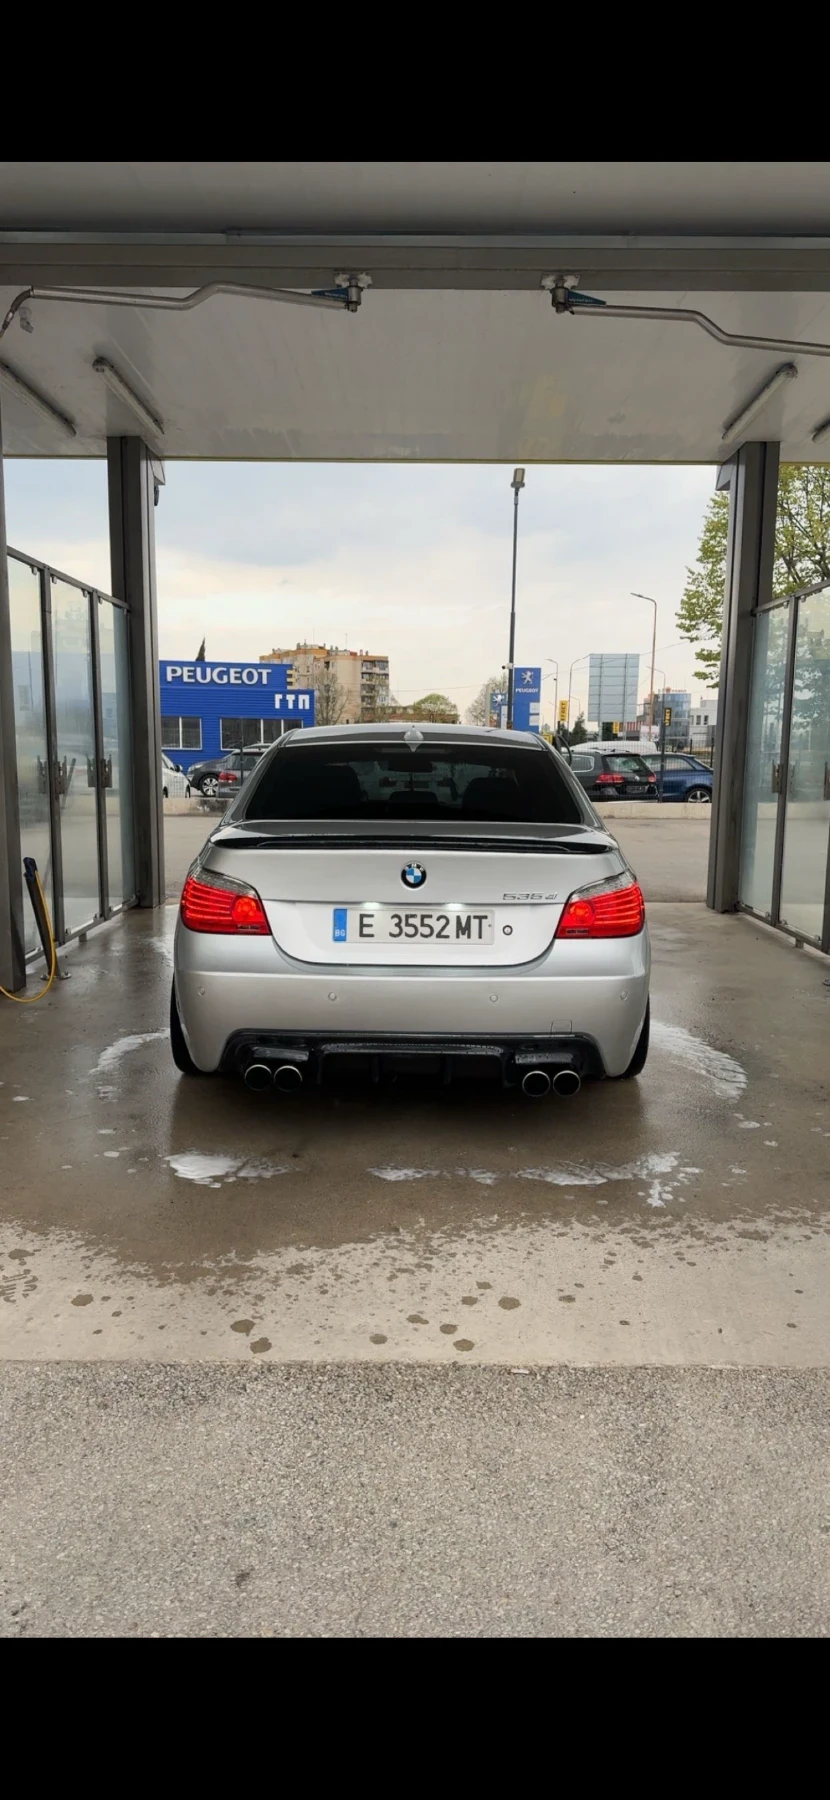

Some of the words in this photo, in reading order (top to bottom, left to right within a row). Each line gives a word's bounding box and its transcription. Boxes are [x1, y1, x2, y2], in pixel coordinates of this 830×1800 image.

[166, 666, 272, 685] PEUGEOT
[274, 694, 310, 710] ГТП
[335, 929, 346, 937] BG
[359, 914, 375, 938] E
[389, 914, 450, 939] 3552
[456, 915, 488, 940] MT
